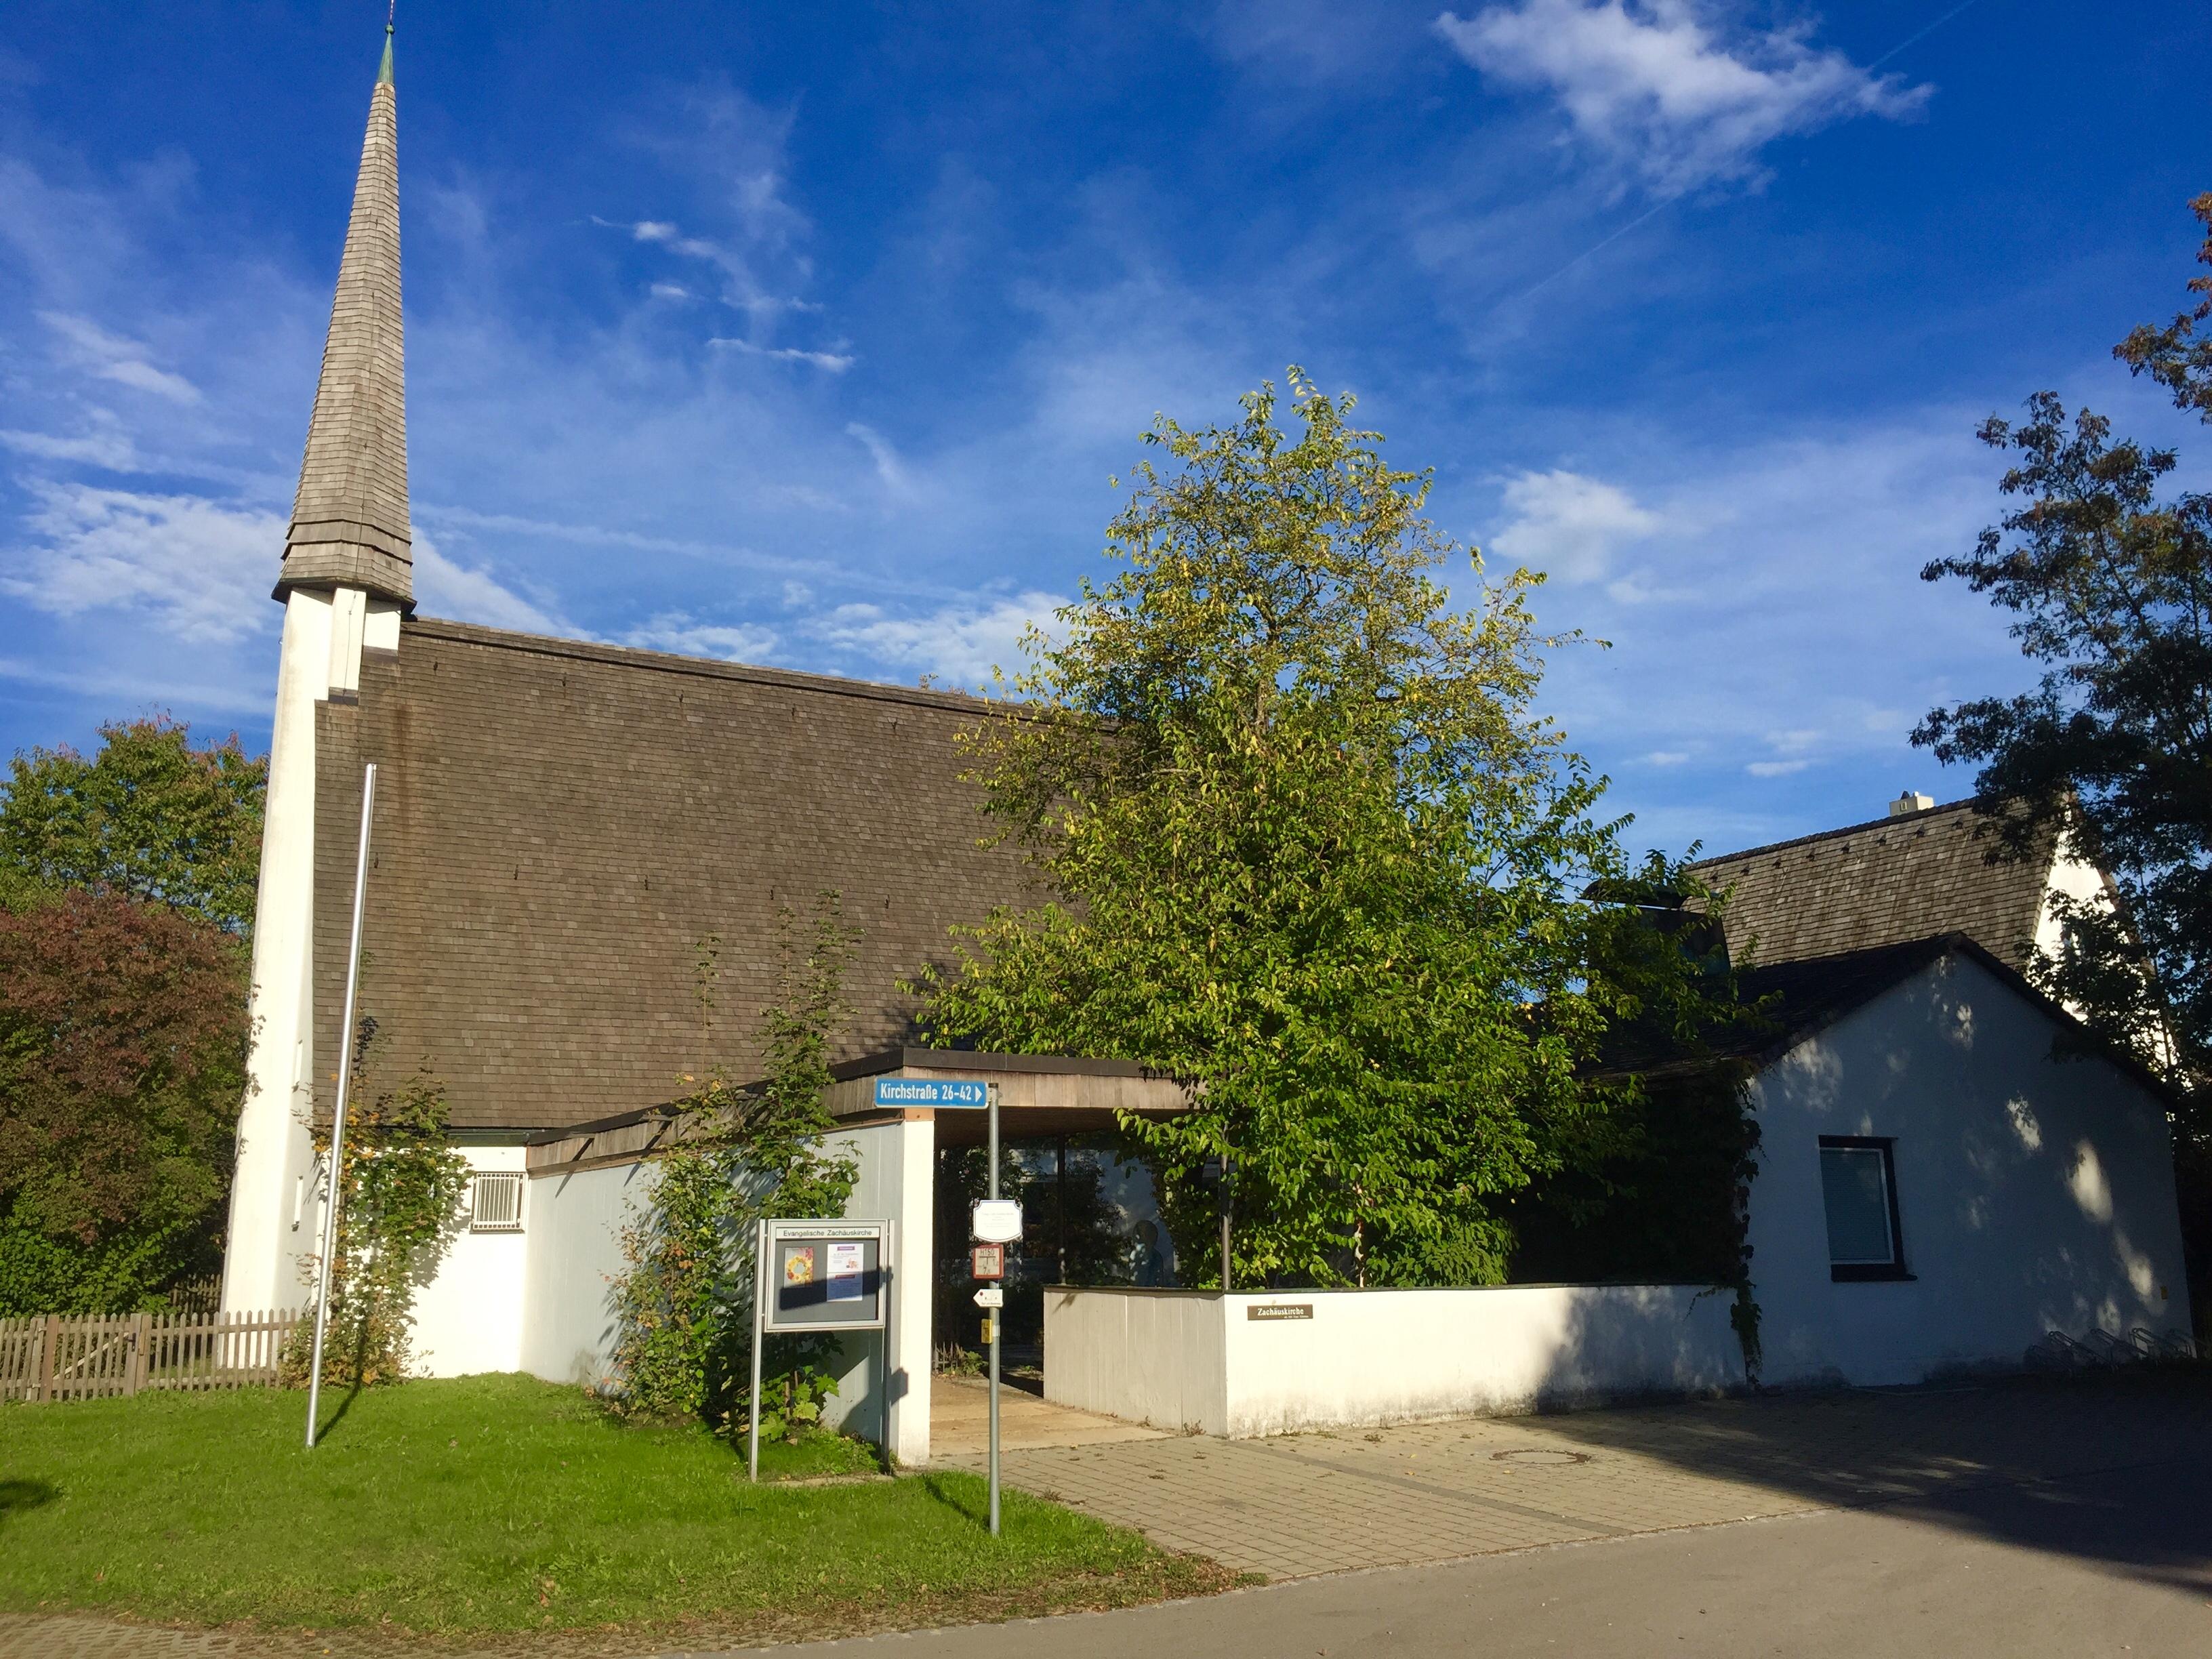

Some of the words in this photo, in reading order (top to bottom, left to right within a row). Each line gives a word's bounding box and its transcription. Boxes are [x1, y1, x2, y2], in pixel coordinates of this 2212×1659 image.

[880, 1082, 938, 1100] Kirchstraße
[941, 1084, 972, 1101] 26-42
[1257, 1307, 1304, 1315] Zachäuskirche
